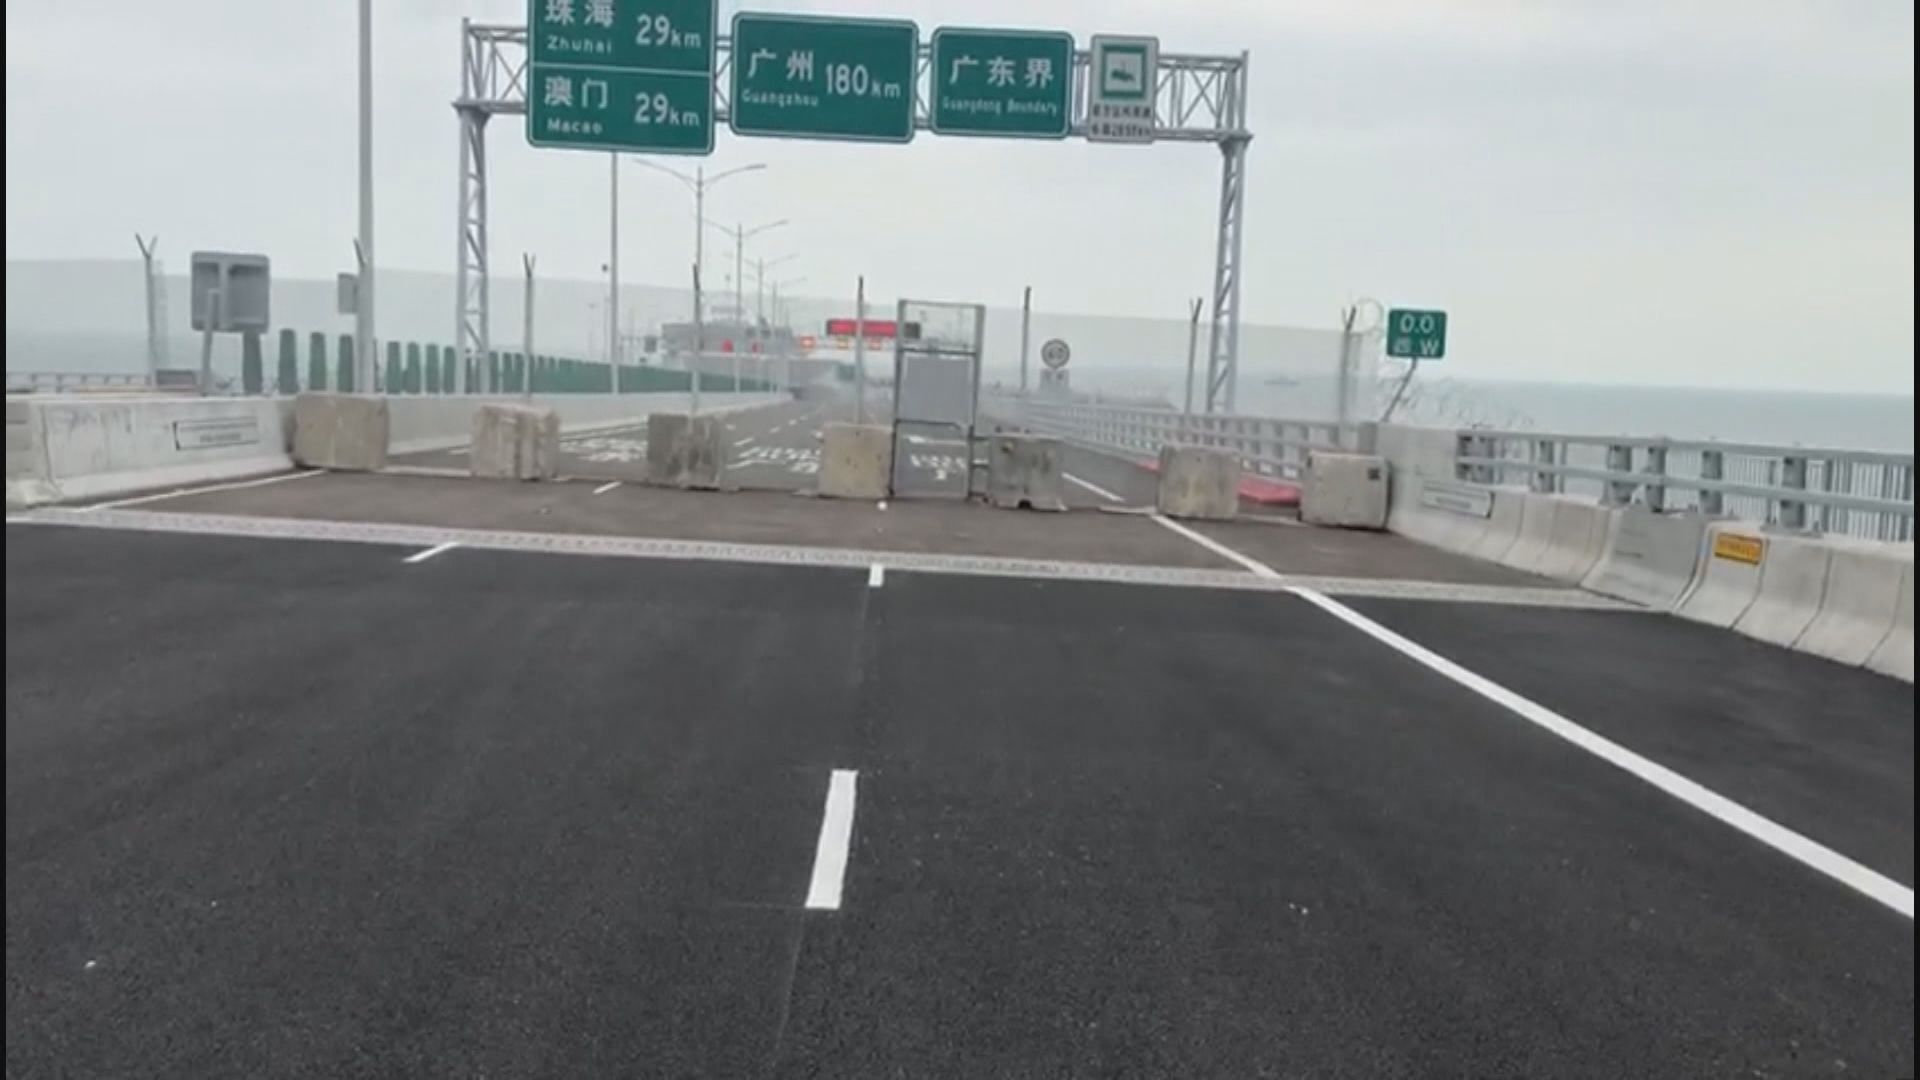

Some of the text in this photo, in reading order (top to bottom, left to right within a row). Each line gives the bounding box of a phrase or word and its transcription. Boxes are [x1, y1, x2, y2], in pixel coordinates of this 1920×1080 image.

[544, 0, 615, 27] 珠海
[547, 34, 612, 54] Zhuhai
[635, 14, 702, 48] 29km
[747, 48, 815, 82] 广州
[825, 63, 901, 98] 180km
[949, 55, 1055, 89] 广东界
[543, 75, 608, 109] 澳门
[741, 88, 819, 108] Guangzhou
[547, 117, 603, 135] Macao
[633, 92, 700, 127] 29km
